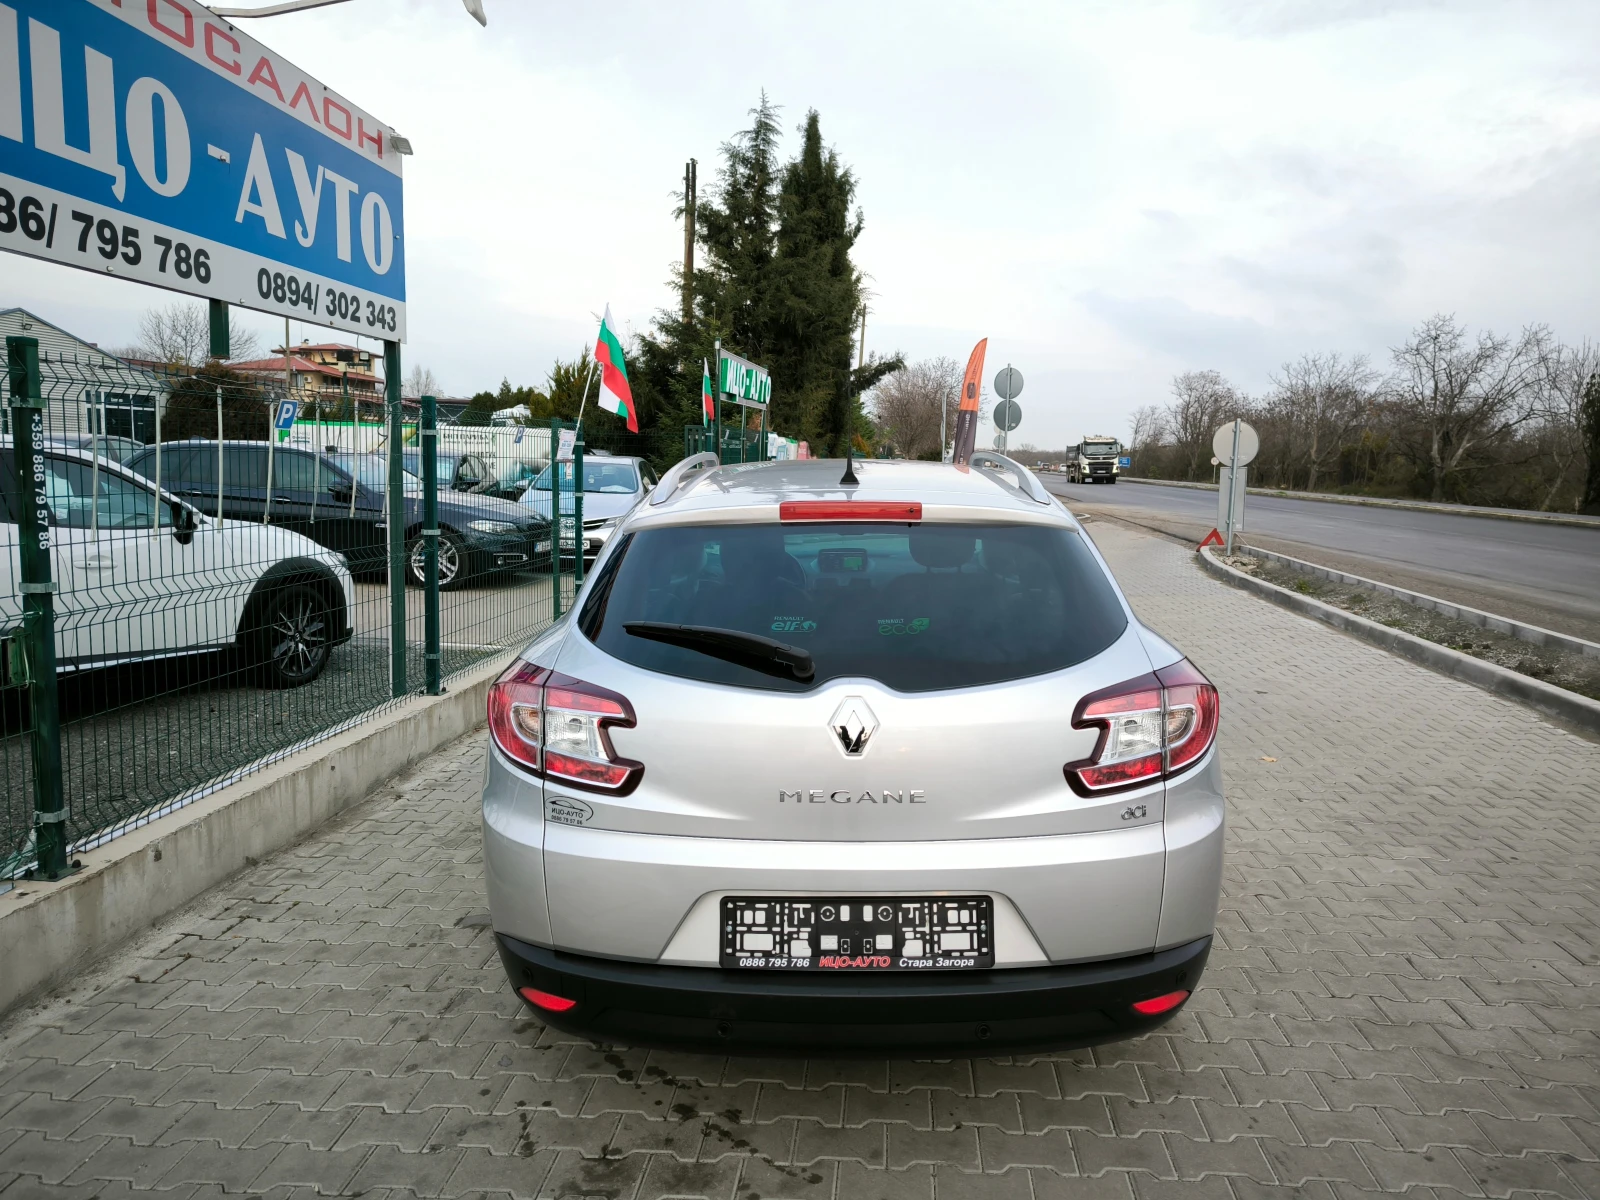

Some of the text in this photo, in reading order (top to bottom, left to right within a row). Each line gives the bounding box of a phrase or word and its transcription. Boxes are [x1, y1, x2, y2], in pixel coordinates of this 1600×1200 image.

[111, 0, 383, 159] ОСАЛОН
[71, 209, 142, 266] 795
[153, 234, 211, 284] 786
[257, 268, 396, 332] 0894/ 302 343
[725, 358, 772, 405] ИЦО-АУТО
[31, 413, 50, 550] +359 886 79 57 86
[552, 807, 583, 818] ИЦО-АУТО
[779, 788, 927, 804] MEGANE
[739, 955, 975, 969] 0886 795 786 ИЦО-АУТО Стара Загора
